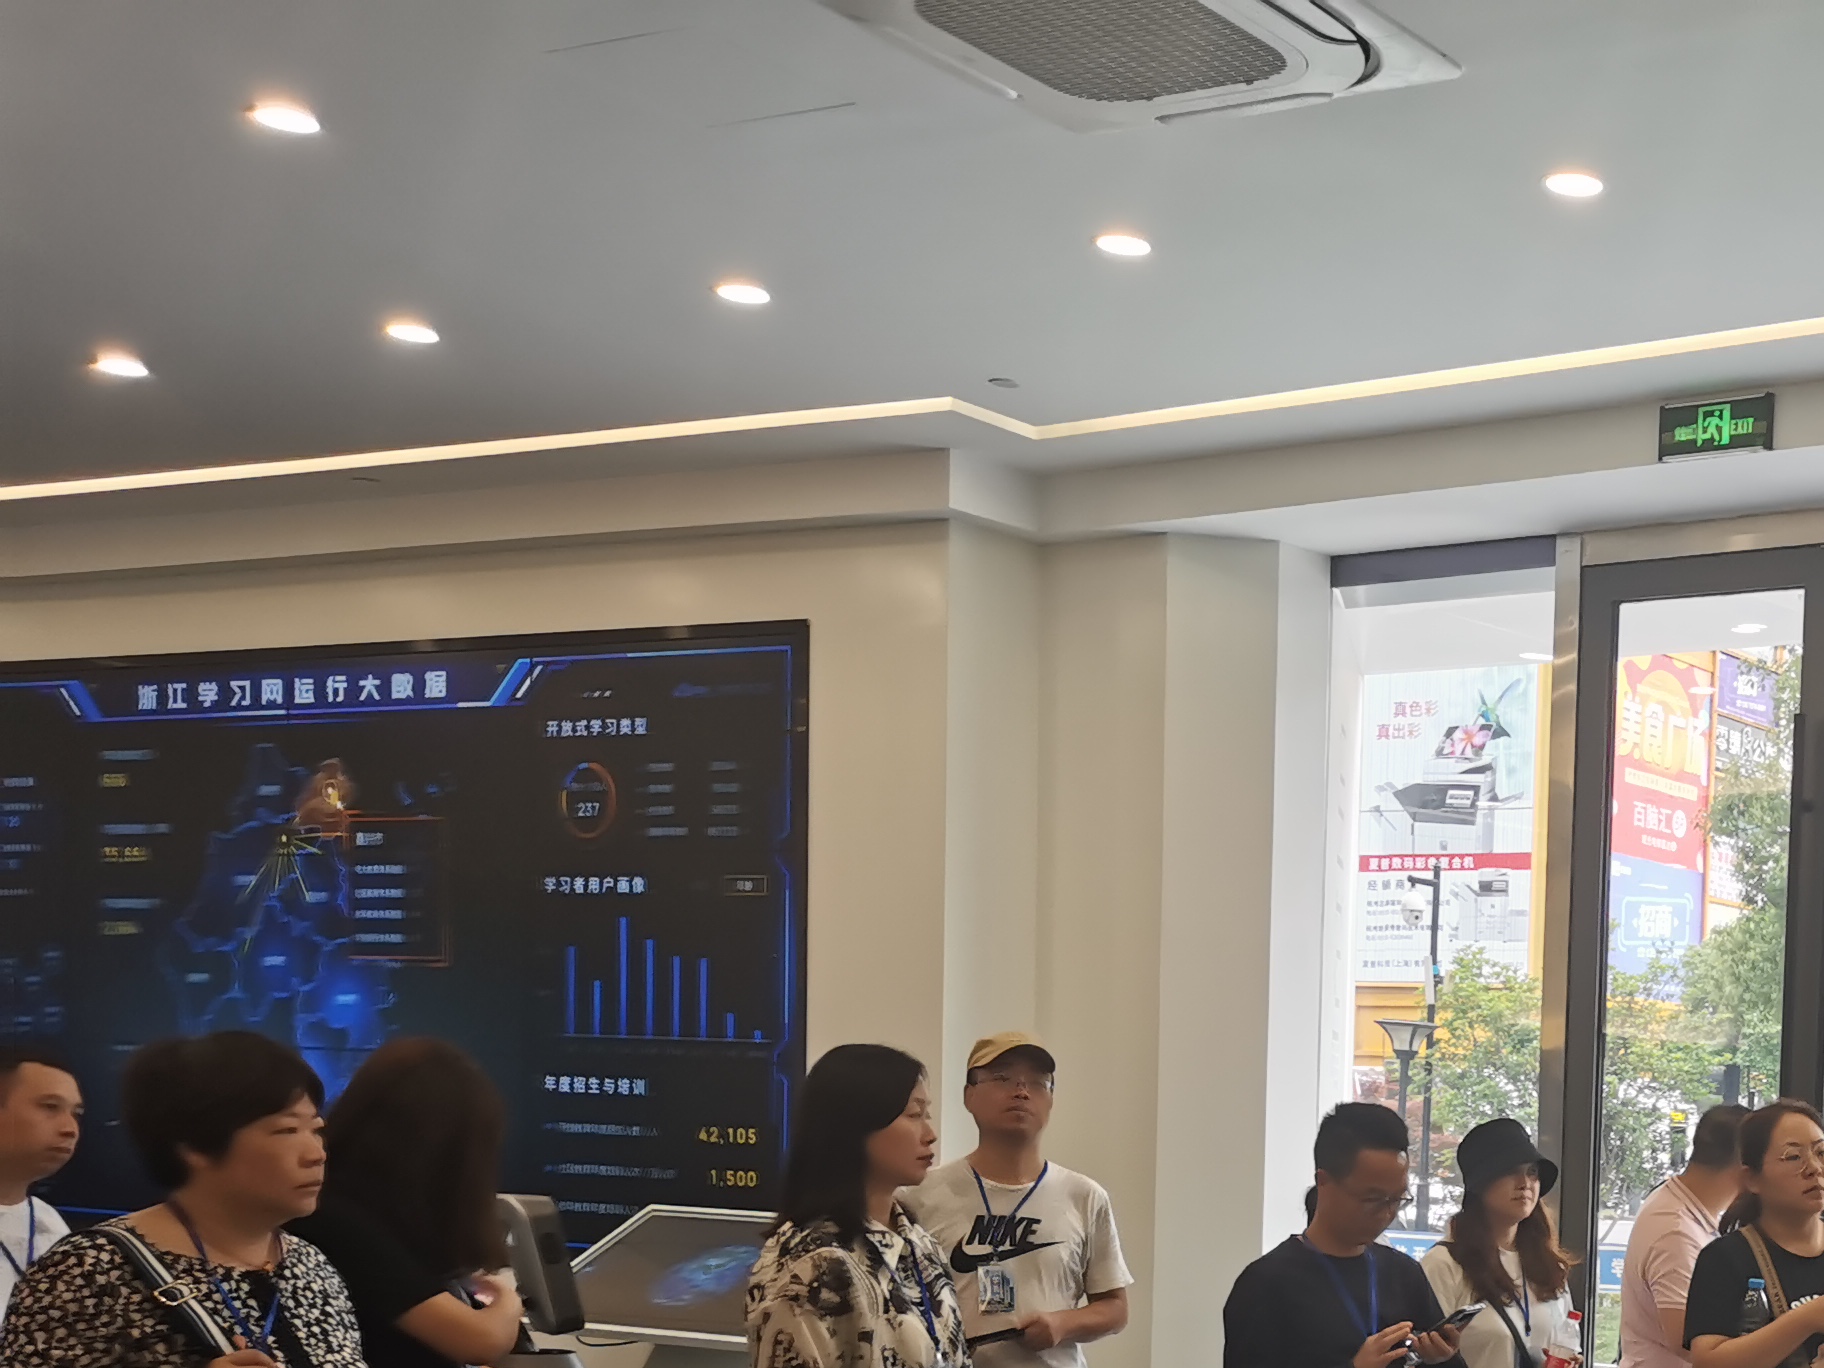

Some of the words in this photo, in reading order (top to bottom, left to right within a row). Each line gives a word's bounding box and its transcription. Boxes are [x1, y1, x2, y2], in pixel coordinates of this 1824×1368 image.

[1730, 417, 1754, 435] EXIT
[137, 670, 448, 712] 浙江学习网运行大数据
[1393, 699, 1440, 719] 真色彩
[545, 716, 648, 738] 开放式学习类型
[1376, 721, 1423, 741] 真出彩
[1618, 690, 1706, 777] 美食广场
[577, 802, 601, 818] 237
[1633, 800, 1672, 836] 百脑汇
[544, 875, 646, 895] 学习者用户画像
[1638, 905, 1673, 939] 招商
[543, 1074, 646, 1097] 年度招生与培训
[697, 1126, 757, 1147] 42,105
[709, 1169, 758, 1189] 1,500
[965, 1214, 1042, 1247] NIKE
